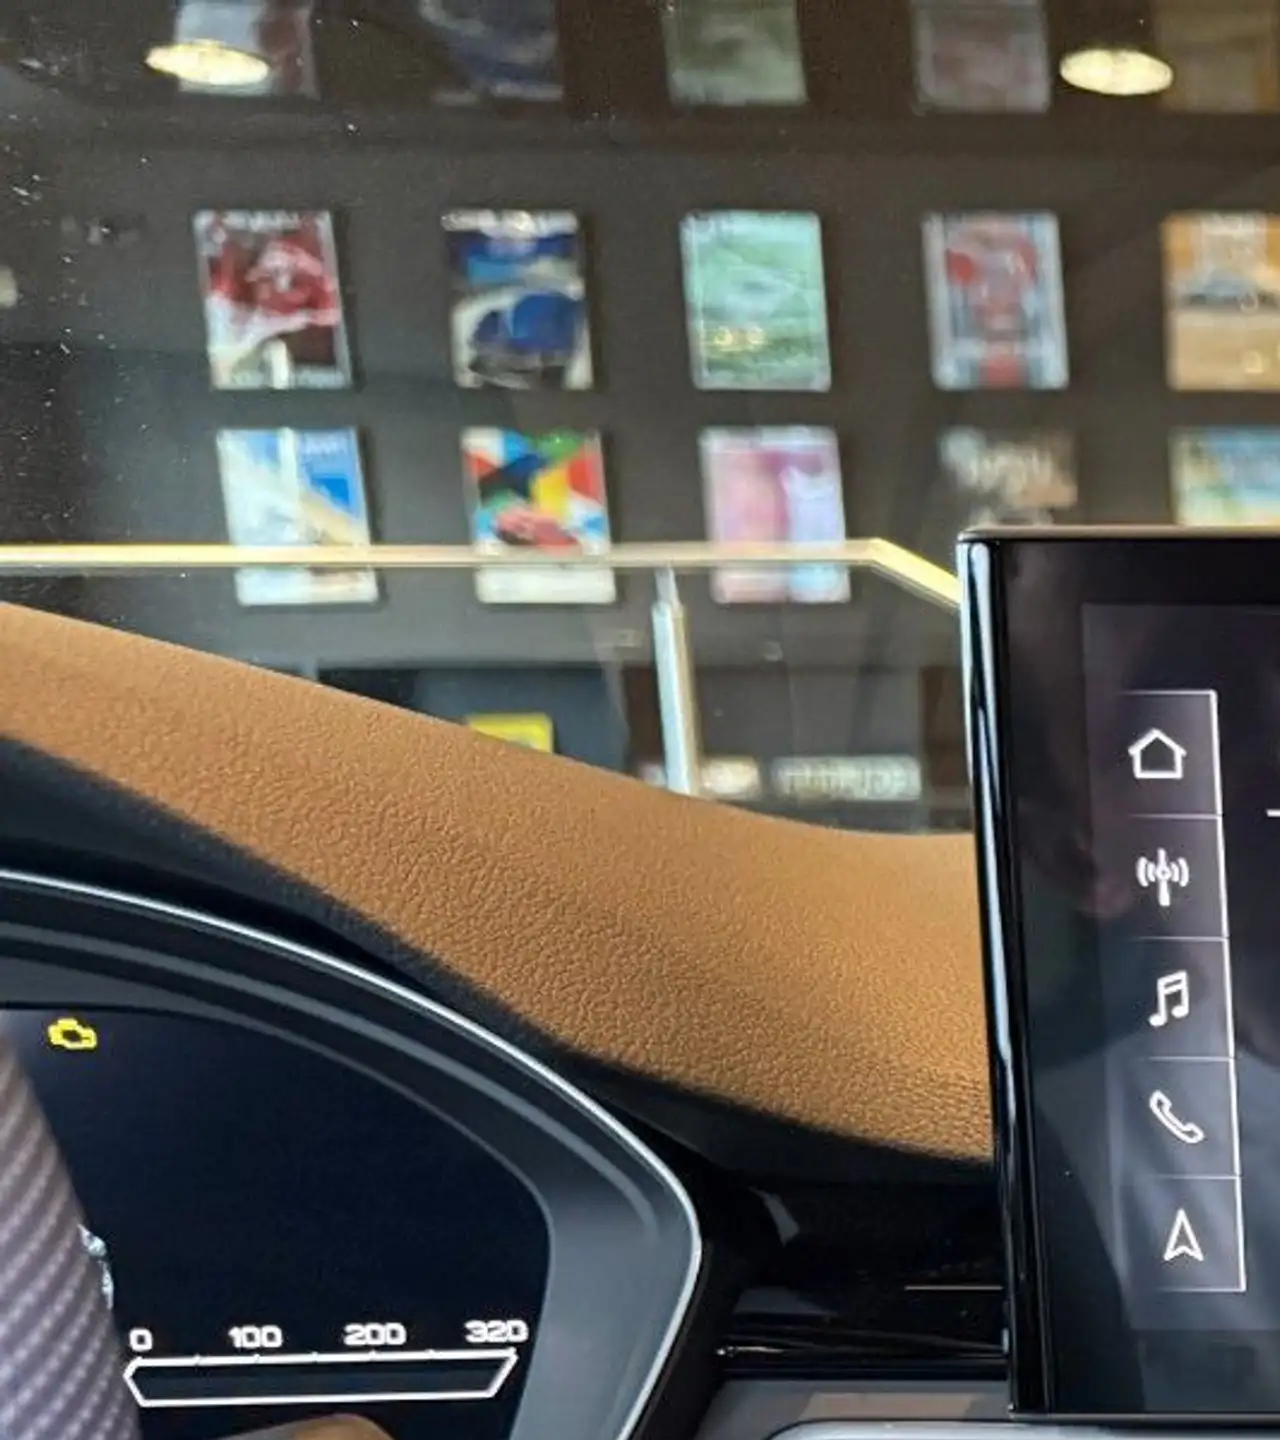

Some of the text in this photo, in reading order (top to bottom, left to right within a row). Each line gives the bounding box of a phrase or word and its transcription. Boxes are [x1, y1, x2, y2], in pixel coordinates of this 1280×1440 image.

[129, 1328, 153, 1352] 0
[228, 1325, 284, 1349] 100
[343, 1322, 407, 1346] 200
[465, 1318, 529, 1343] 320
